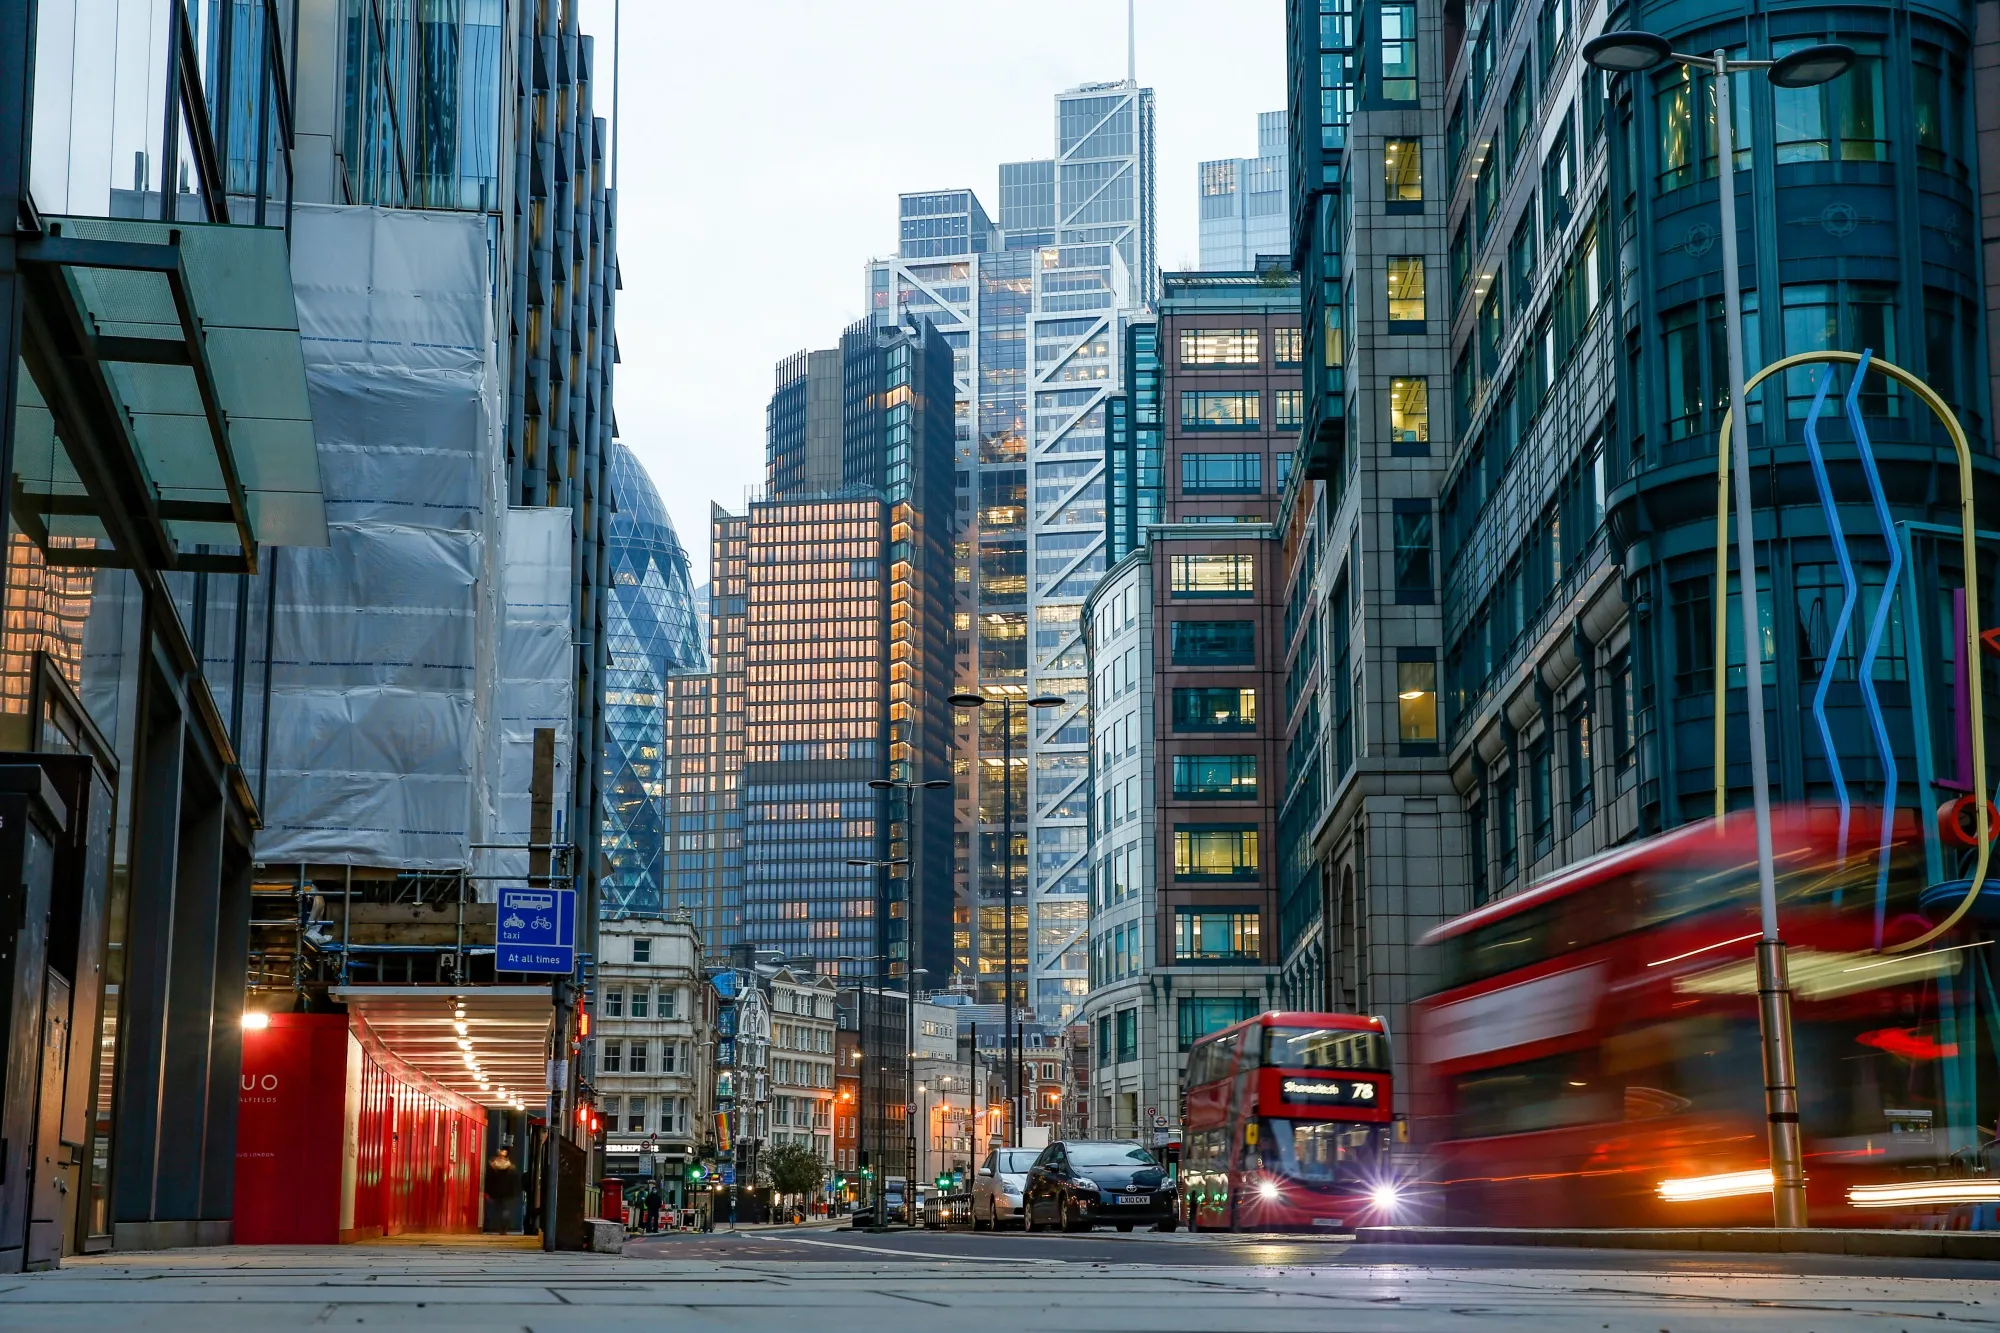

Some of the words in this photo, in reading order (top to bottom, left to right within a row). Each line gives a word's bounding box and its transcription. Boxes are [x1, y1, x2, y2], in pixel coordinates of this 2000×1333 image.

[503, 931, 520, 940] taxi
[508, 953, 518, 962] At
[521, 954, 533, 963] all
[536, 955, 560, 964] times
[1351, 1083, 1374, 1099] 78
[1121, 1196, 1134, 1204] LX10
